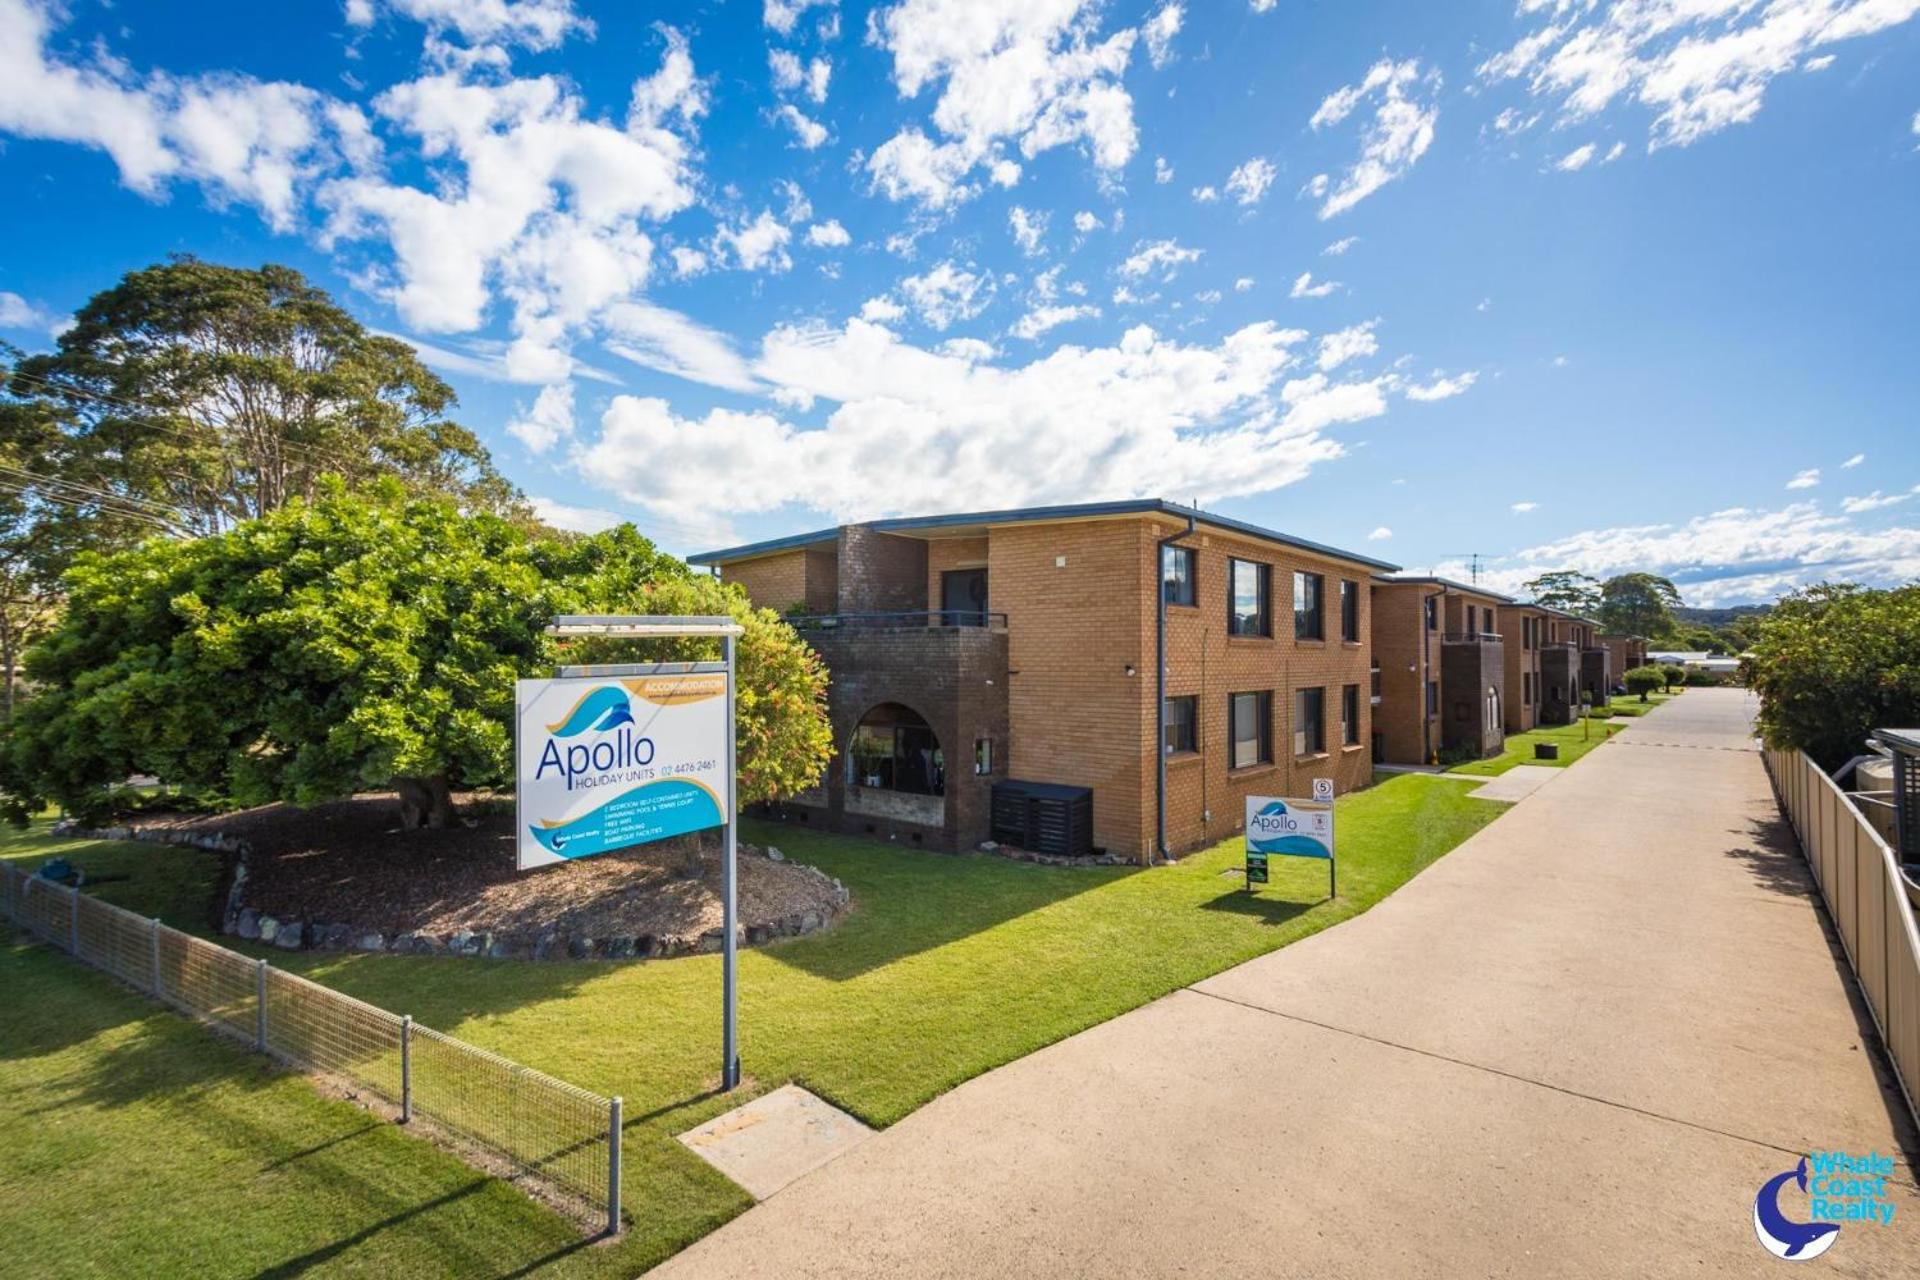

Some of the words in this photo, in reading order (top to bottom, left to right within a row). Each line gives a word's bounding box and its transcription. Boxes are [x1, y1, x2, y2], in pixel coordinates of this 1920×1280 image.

[535, 728, 655, 790] Apollo
[575, 773, 623, 789] HOLIDAY
[626, 768, 655, 781] UNITS
[661, 766, 672, 776] 02
[675, 763, 695, 773] 4476
[697, 760, 716, 771] 2461
[1320, 783, 1327, 792] 5
[604, 810, 636, 820] SWIMMING
[658, 801, 676, 810] TENNIS
[677, 799, 694, 807] COURT
[609, 801, 639, 811] BEDROOM
[683, 790, 699, 798] UNITS
[604, 828, 619, 836] BOAT
[621, 822, 645, 833] PARKING
[1250, 811, 1297, 832] Apollo
[604, 833, 635, 844] BARBECUE
[636, 827, 663, 838] FACILITIES
